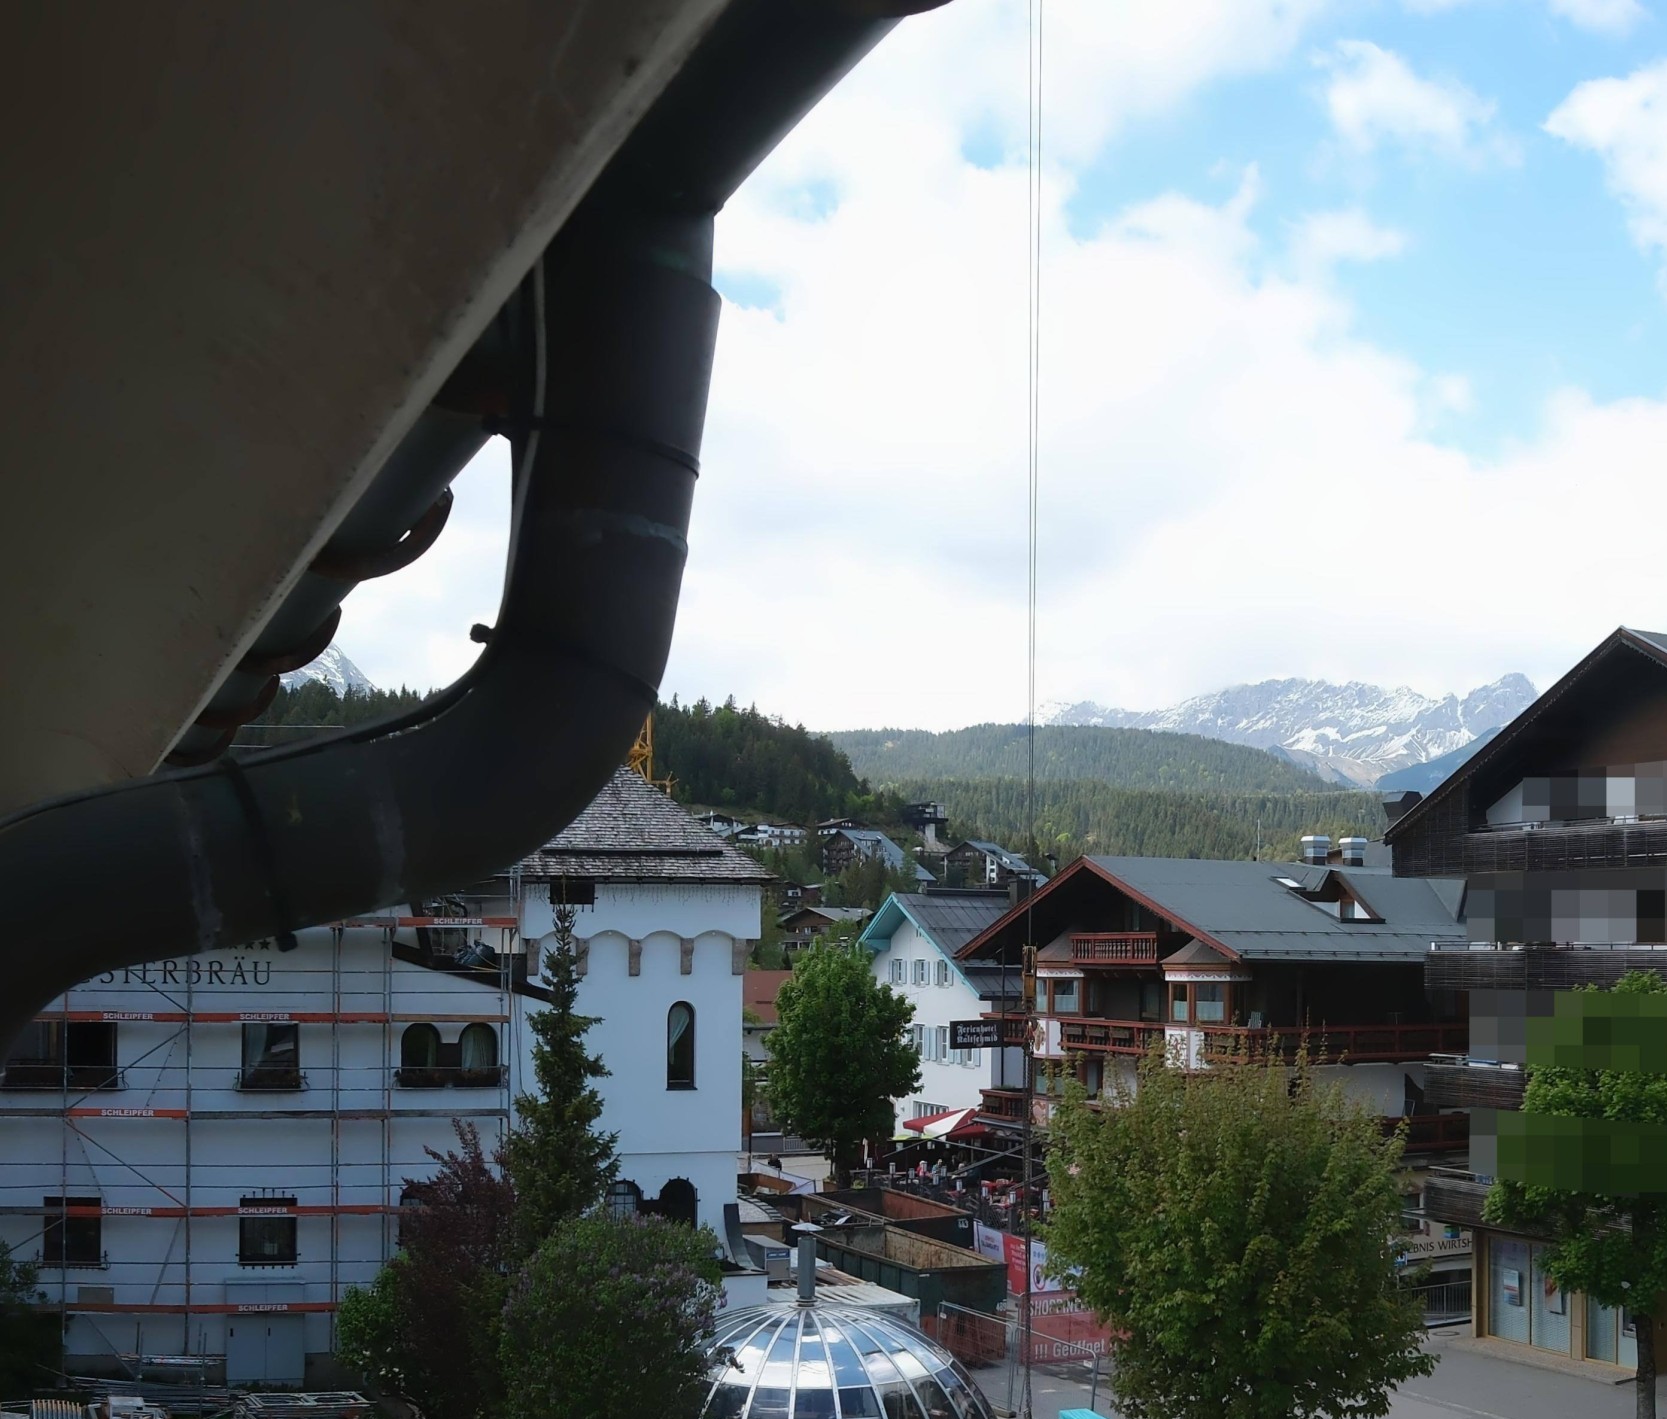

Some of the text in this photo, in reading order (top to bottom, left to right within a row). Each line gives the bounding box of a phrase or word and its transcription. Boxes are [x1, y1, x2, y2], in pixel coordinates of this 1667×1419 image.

[80, 956, 274, 986] STERBRÄU
[102, 1012, 154, 1020] SCHLEIPFER
[956, 1024, 997, 1035] Ferienhotel
[102, 1207, 152, 1215] SCHLEIPFER
[238, 1206, 288, 1214] SCHLEIPFER
[238, 1304, 288, 1312] SCHLEIPFER
[1052, 1338, 1106, 1358] Geöffnet
